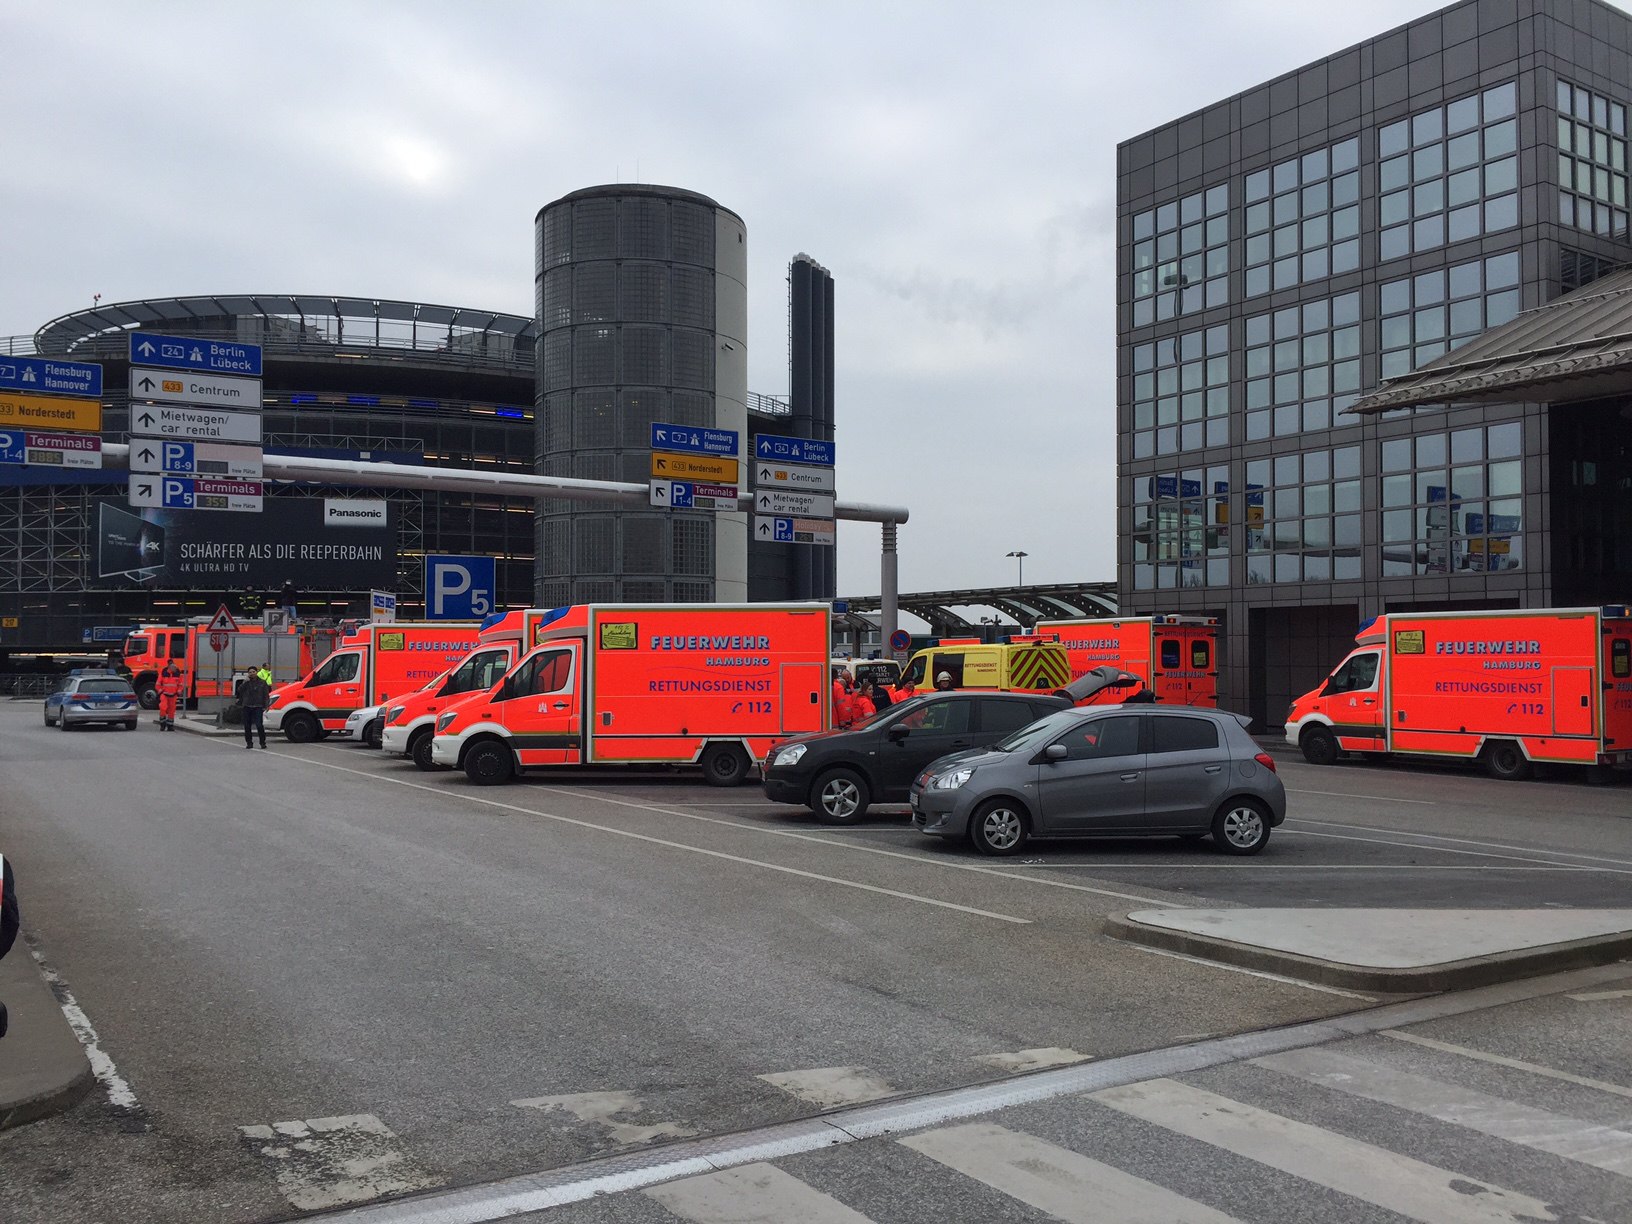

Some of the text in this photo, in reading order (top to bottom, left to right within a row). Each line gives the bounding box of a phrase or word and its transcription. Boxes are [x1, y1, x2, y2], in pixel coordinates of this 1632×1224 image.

[168, 347, 179, 356] 24
[210, 344, 245, 357] Berlin
[210, 357, 252, 370] Lübeck
[45, 364, 92, 380] Flensburg
[45, 377, 90, 391] Hannover
[164, 382, 181, 391] 433
[190, 384, 240, 397] Centrum
[0, 404, 11, 413] 33
[19, 405, 76, 420] Norderstedt
[161, 410, 230, 425] Mietwagen/
[161, 425, 220, 436] car rental
[30, 435, 94, 449] Terminals
[704, 431, 733, 444] Flensburg
[704, 442, 732, 452] Hannover
[804, 442, 826, 452] Berlin
[2, 449, 23, 460] 1-4
[804, 452, 829, 462] Lübeck
[174, 461, 192, 470] 8-9
[688, 463, 723, 474] Norderstedt
[791, 472, 822, 483] Centrum
[198, 481, 255, 494] Terminals
[695, 485, 734, 497] Terminals
[679, 497, 692, 505] 1-4
[773, 493, 816, 505] Mietwagen/
[329, 508, 382, 518] Panasonic
[788, 505, 810, 514] rental
[146, 541, 160, 551] 4K
[180, 541, 382, 561] SCHÄRFER ALS DIE REEPERBAHN
[180, 563, 249, 573] 4K ULTRA HD TV
[211, 634, 228, 645] STP
[651, 635, 770, 650] FEUERWEHR
[1062, 638, 1120, 649] EUERWEHR
[408, 640, 487, 651] FEUERWEH
[1436, 640, 1541, 654] FEUERWEHR
[705, 657, 770, 667] HAMBURG
[1087, 653, 1121, 661] HAMBURG
[1483, 661, 1541, 670] HAMBURG
[1165, 671, 1207, 679] FEUERWEHR
[649, 680, 772, 692] RETTUNGSDIENST
[1172, 682, 1183, 690] 112
[1435, 681, 1543, 694] RETTUNGSDIENST
[748, 701, 772, 714] 112
[1521, 703, 1544, 715] 112
